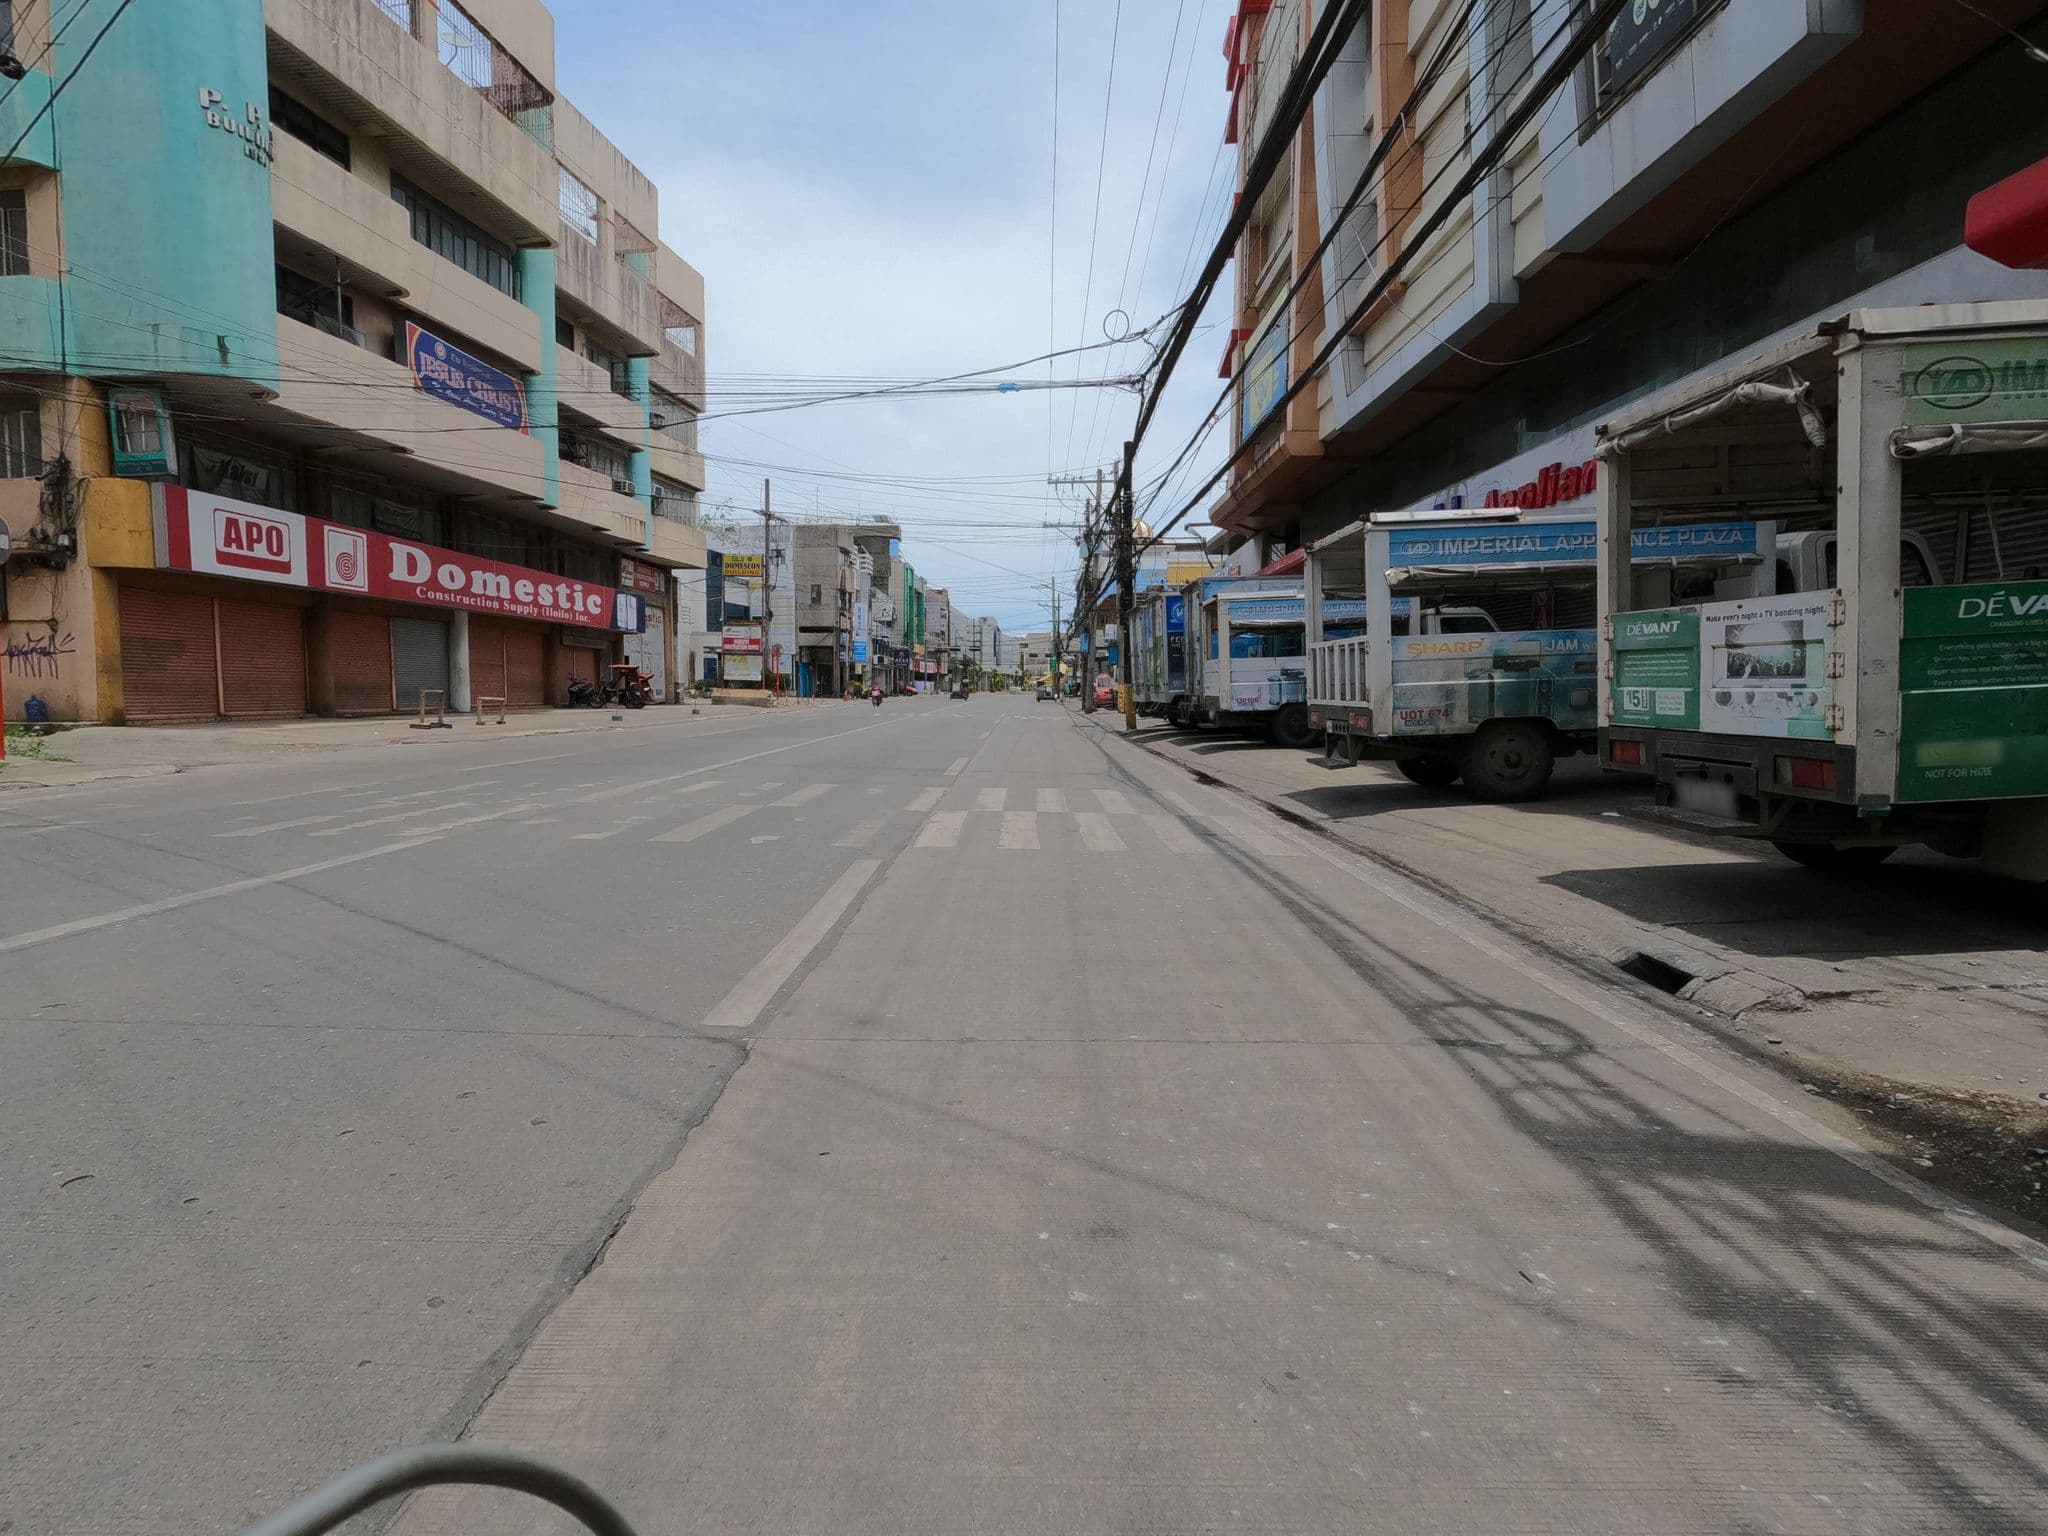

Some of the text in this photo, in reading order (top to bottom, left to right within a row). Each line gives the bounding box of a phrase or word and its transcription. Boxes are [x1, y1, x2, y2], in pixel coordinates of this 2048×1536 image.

[419, 351, 465, 389] JESUS
[466, 376, 519, 416] CHRIST
[223, 517, 283, 556] APO
[1438, 534, 1549, 556] IMPERIAL
[1678, 527, 1745, 545] PLAZA
[388, 541, 602, 615] Domestic
[416, 586, 500, 609] Construction
[503, 600, 539, 616] Supply
[541, 607, 574, 621] (Iloilo)
[1723, 614, 1740, 622] every
[1741, 612, 1758, 621] night
[1765, 610, 1773, 618] TV
[1775, 608, 1803, 617] bonding
[1804, 605, 1827, 616] night.
[1626, 620, 1681, 636] DÉVANT
[1408, 640, 1484, 656] SHARP
[1545, 638, 1578, 651] JAM
[1400, 710, 1425, 720] UOT
[1925, 766, 1992, 779] NOT FOR HIRE
